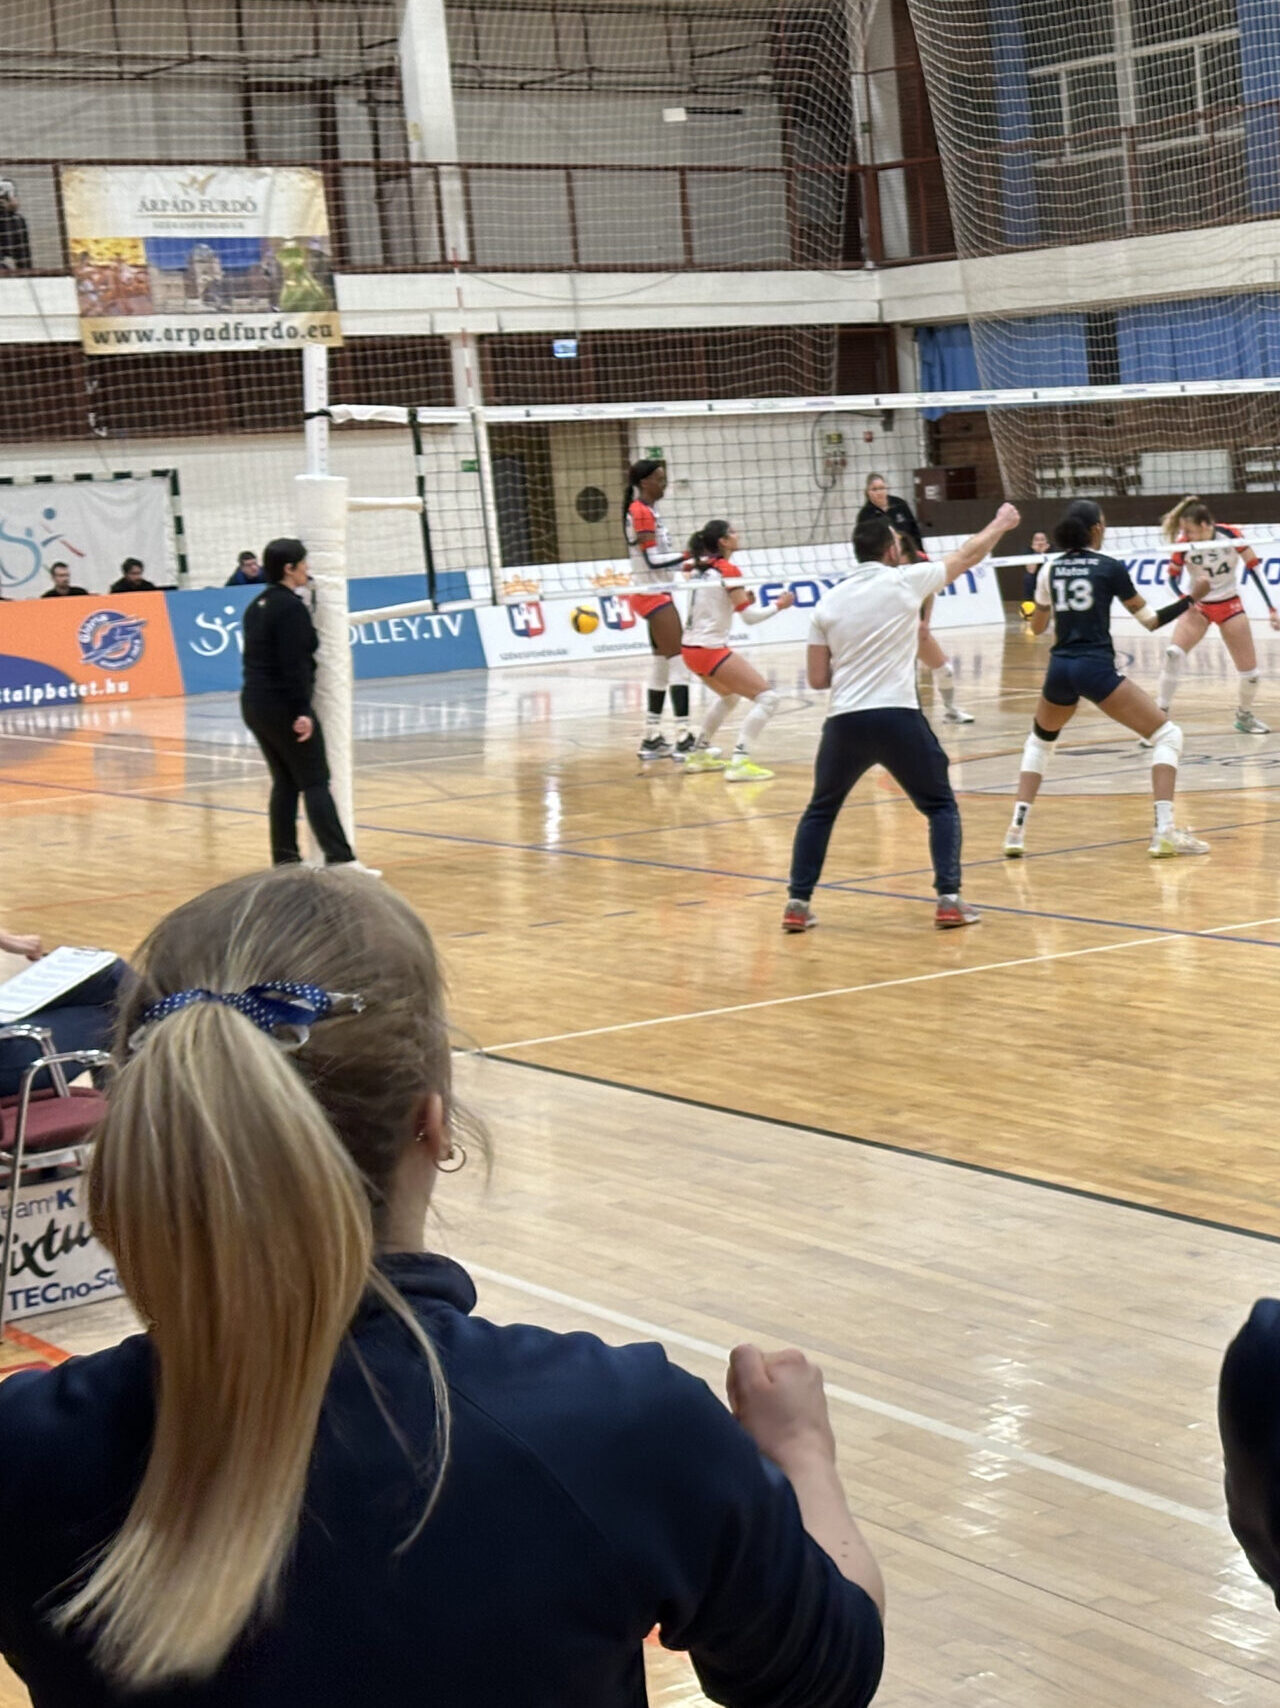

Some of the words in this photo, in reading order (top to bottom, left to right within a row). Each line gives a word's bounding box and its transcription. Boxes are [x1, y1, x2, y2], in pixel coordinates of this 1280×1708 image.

[91, 322, 333, 346] www.arpadfurdo.eu
[1052, 578, 1094, 612] 13
[0, 679, 130, 705] talpbetet.hu
